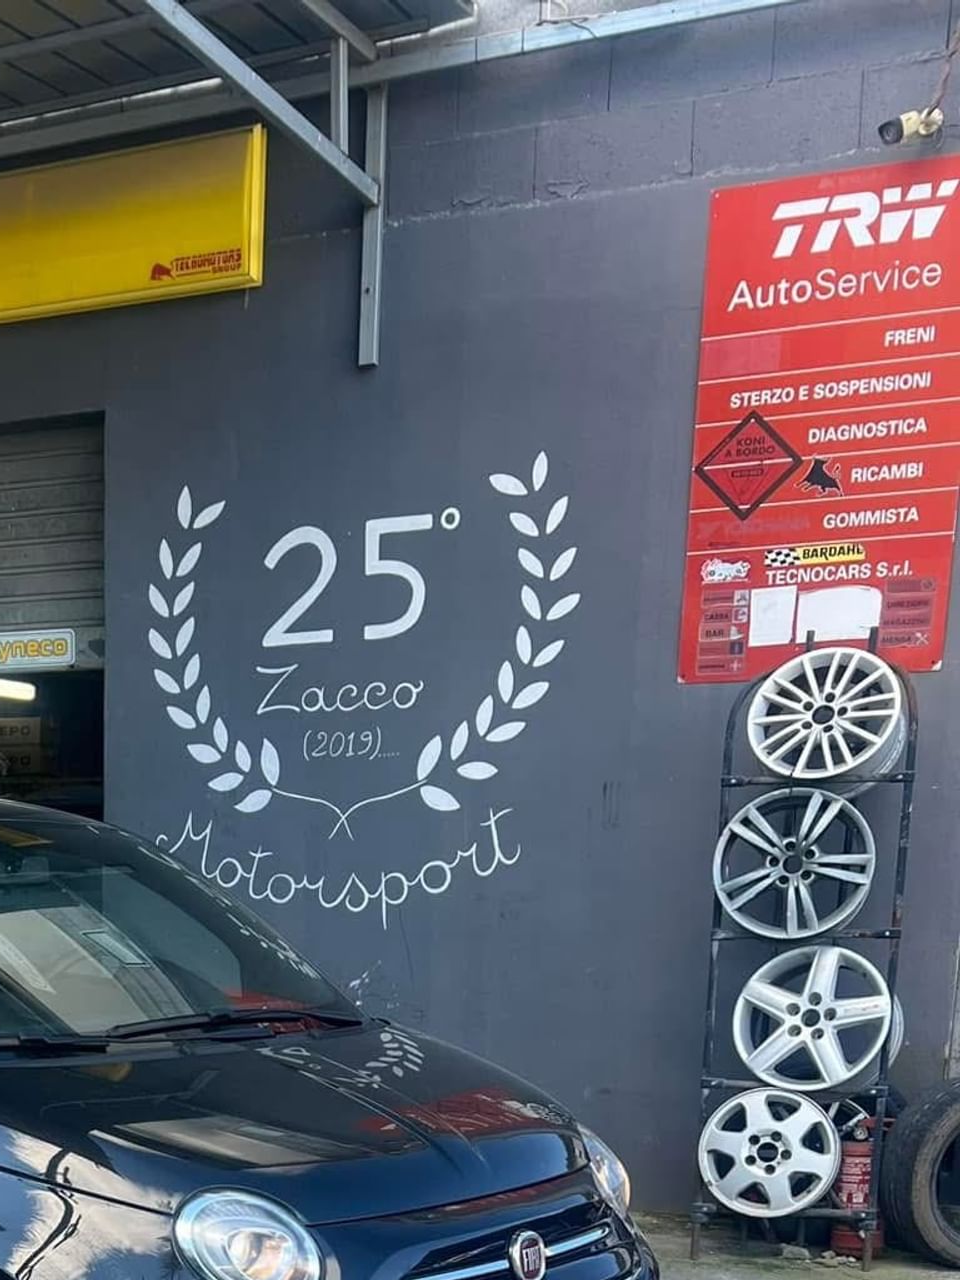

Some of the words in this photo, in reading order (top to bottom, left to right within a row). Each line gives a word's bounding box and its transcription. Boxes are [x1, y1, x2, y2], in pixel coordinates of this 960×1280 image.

[772, 178, 960, 259] TRW
[727, 260, 942, 312] AutoService
[884, 326, 936, 347] FRENI
[730, 387, 795, 408] STERZO
[798, 385, 809, 400] E
[813, 371, 931, 399] SOSPENSIONI
[808, 417, 928, 444] DIAGNOSTICA
[850, 462, 924, 483] RICAMBI
[823, 507, 919, 529] GOMMISTA
[802, 544, 864, 560] BARDAHL
[766, 563, 871, 585] TECNOCARS
[876, 560, 913, 577] S.r.l.
[255, 663, 424, 715] Zacco
[156, 808, 521, 930] Motorsport
